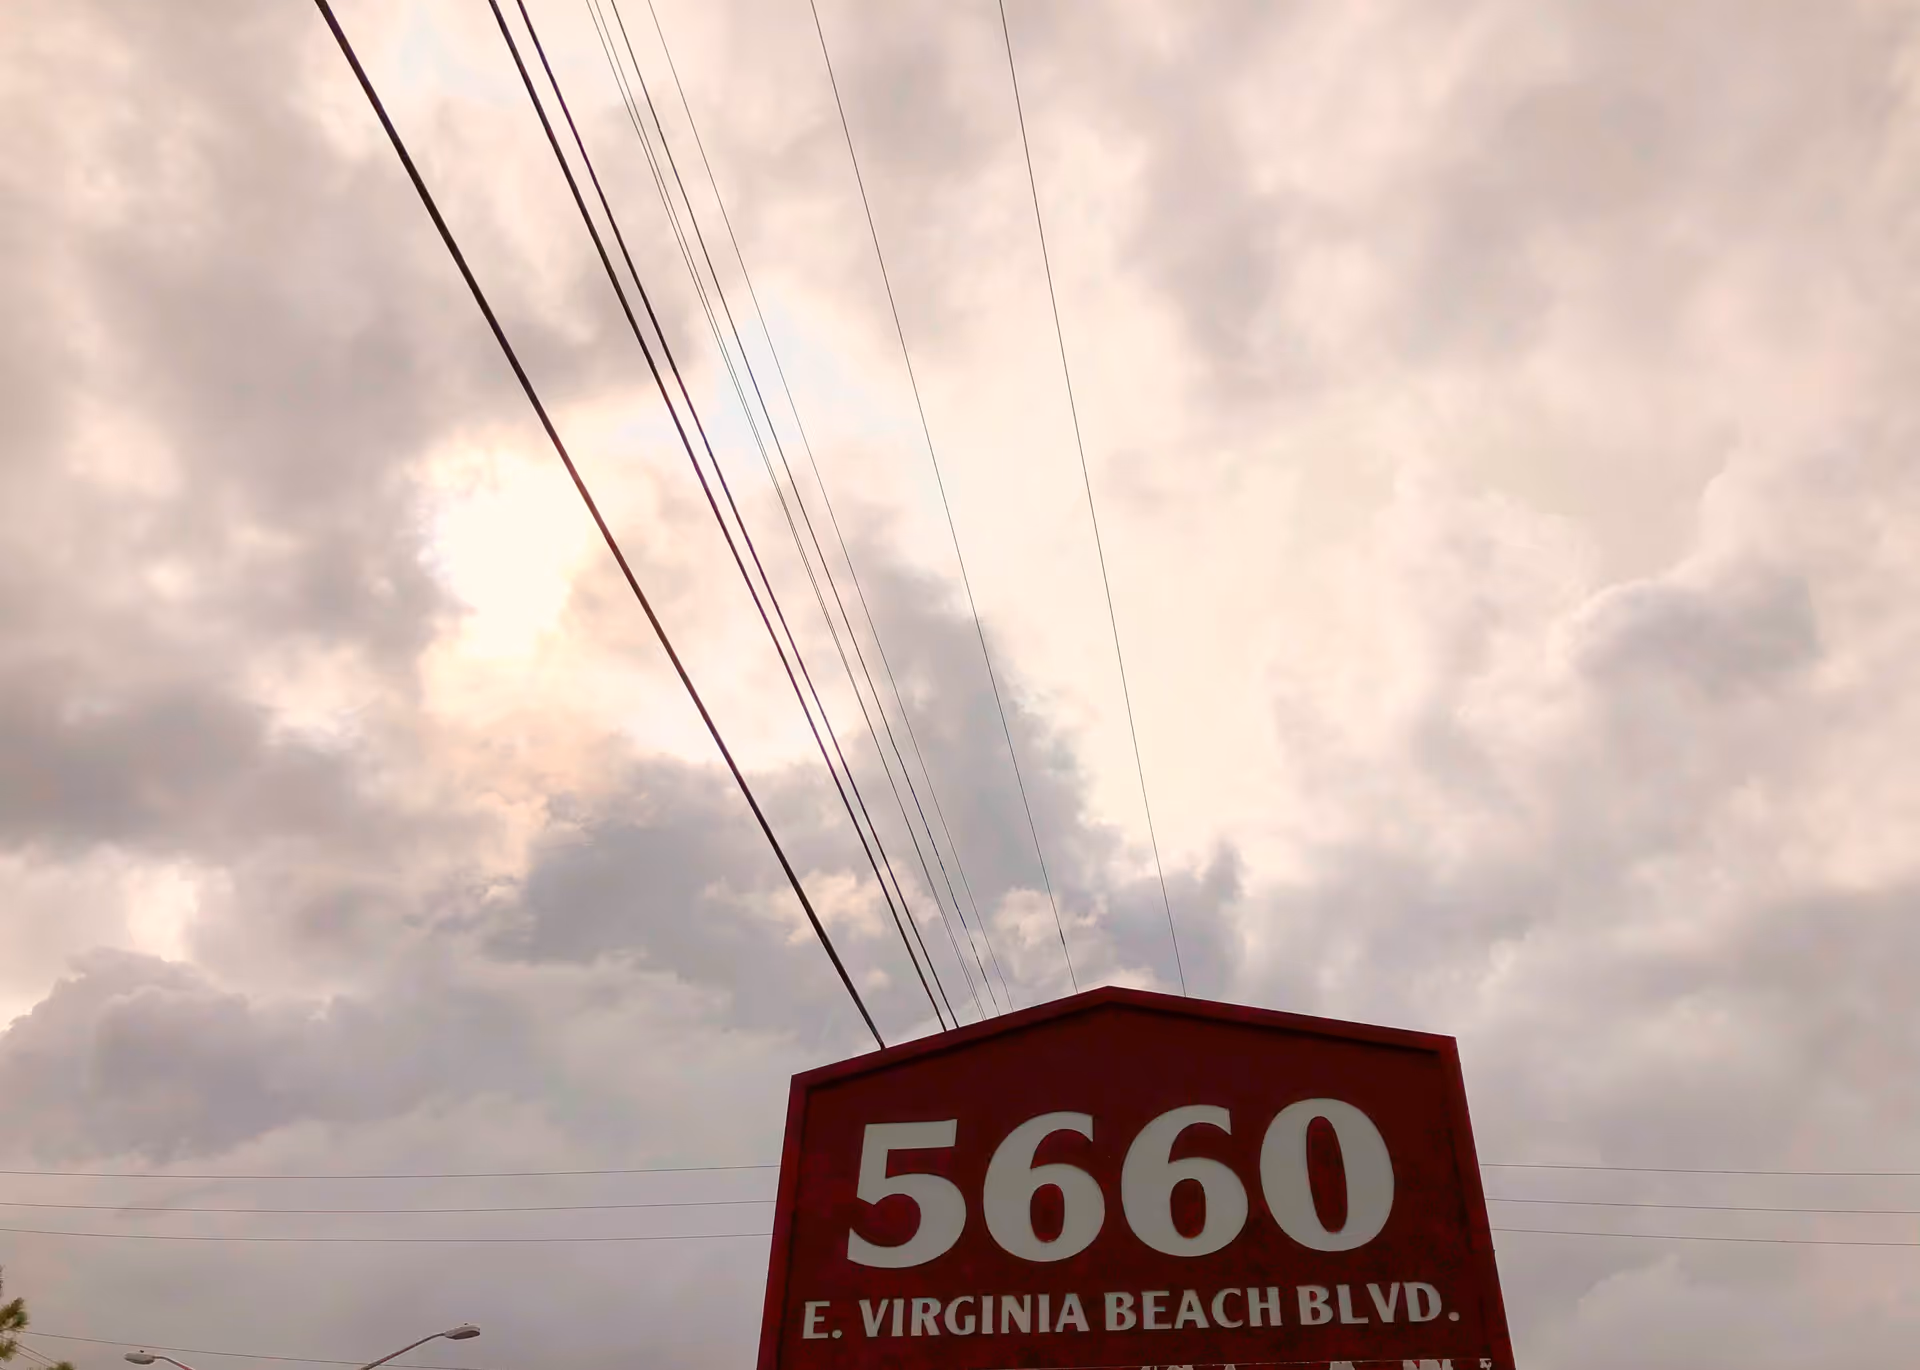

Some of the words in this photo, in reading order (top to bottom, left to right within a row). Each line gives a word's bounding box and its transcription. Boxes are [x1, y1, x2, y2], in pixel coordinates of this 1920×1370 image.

[846, 1098, 1396, 1269] 5660
[803, 1301, 843, 1339] E.
[859, 1294, 1089, 1338] VIRGINIA
[1104, 1286, 1282, 1331] BEACH
[1297, 1282, 1460, 1326] BLVD.
